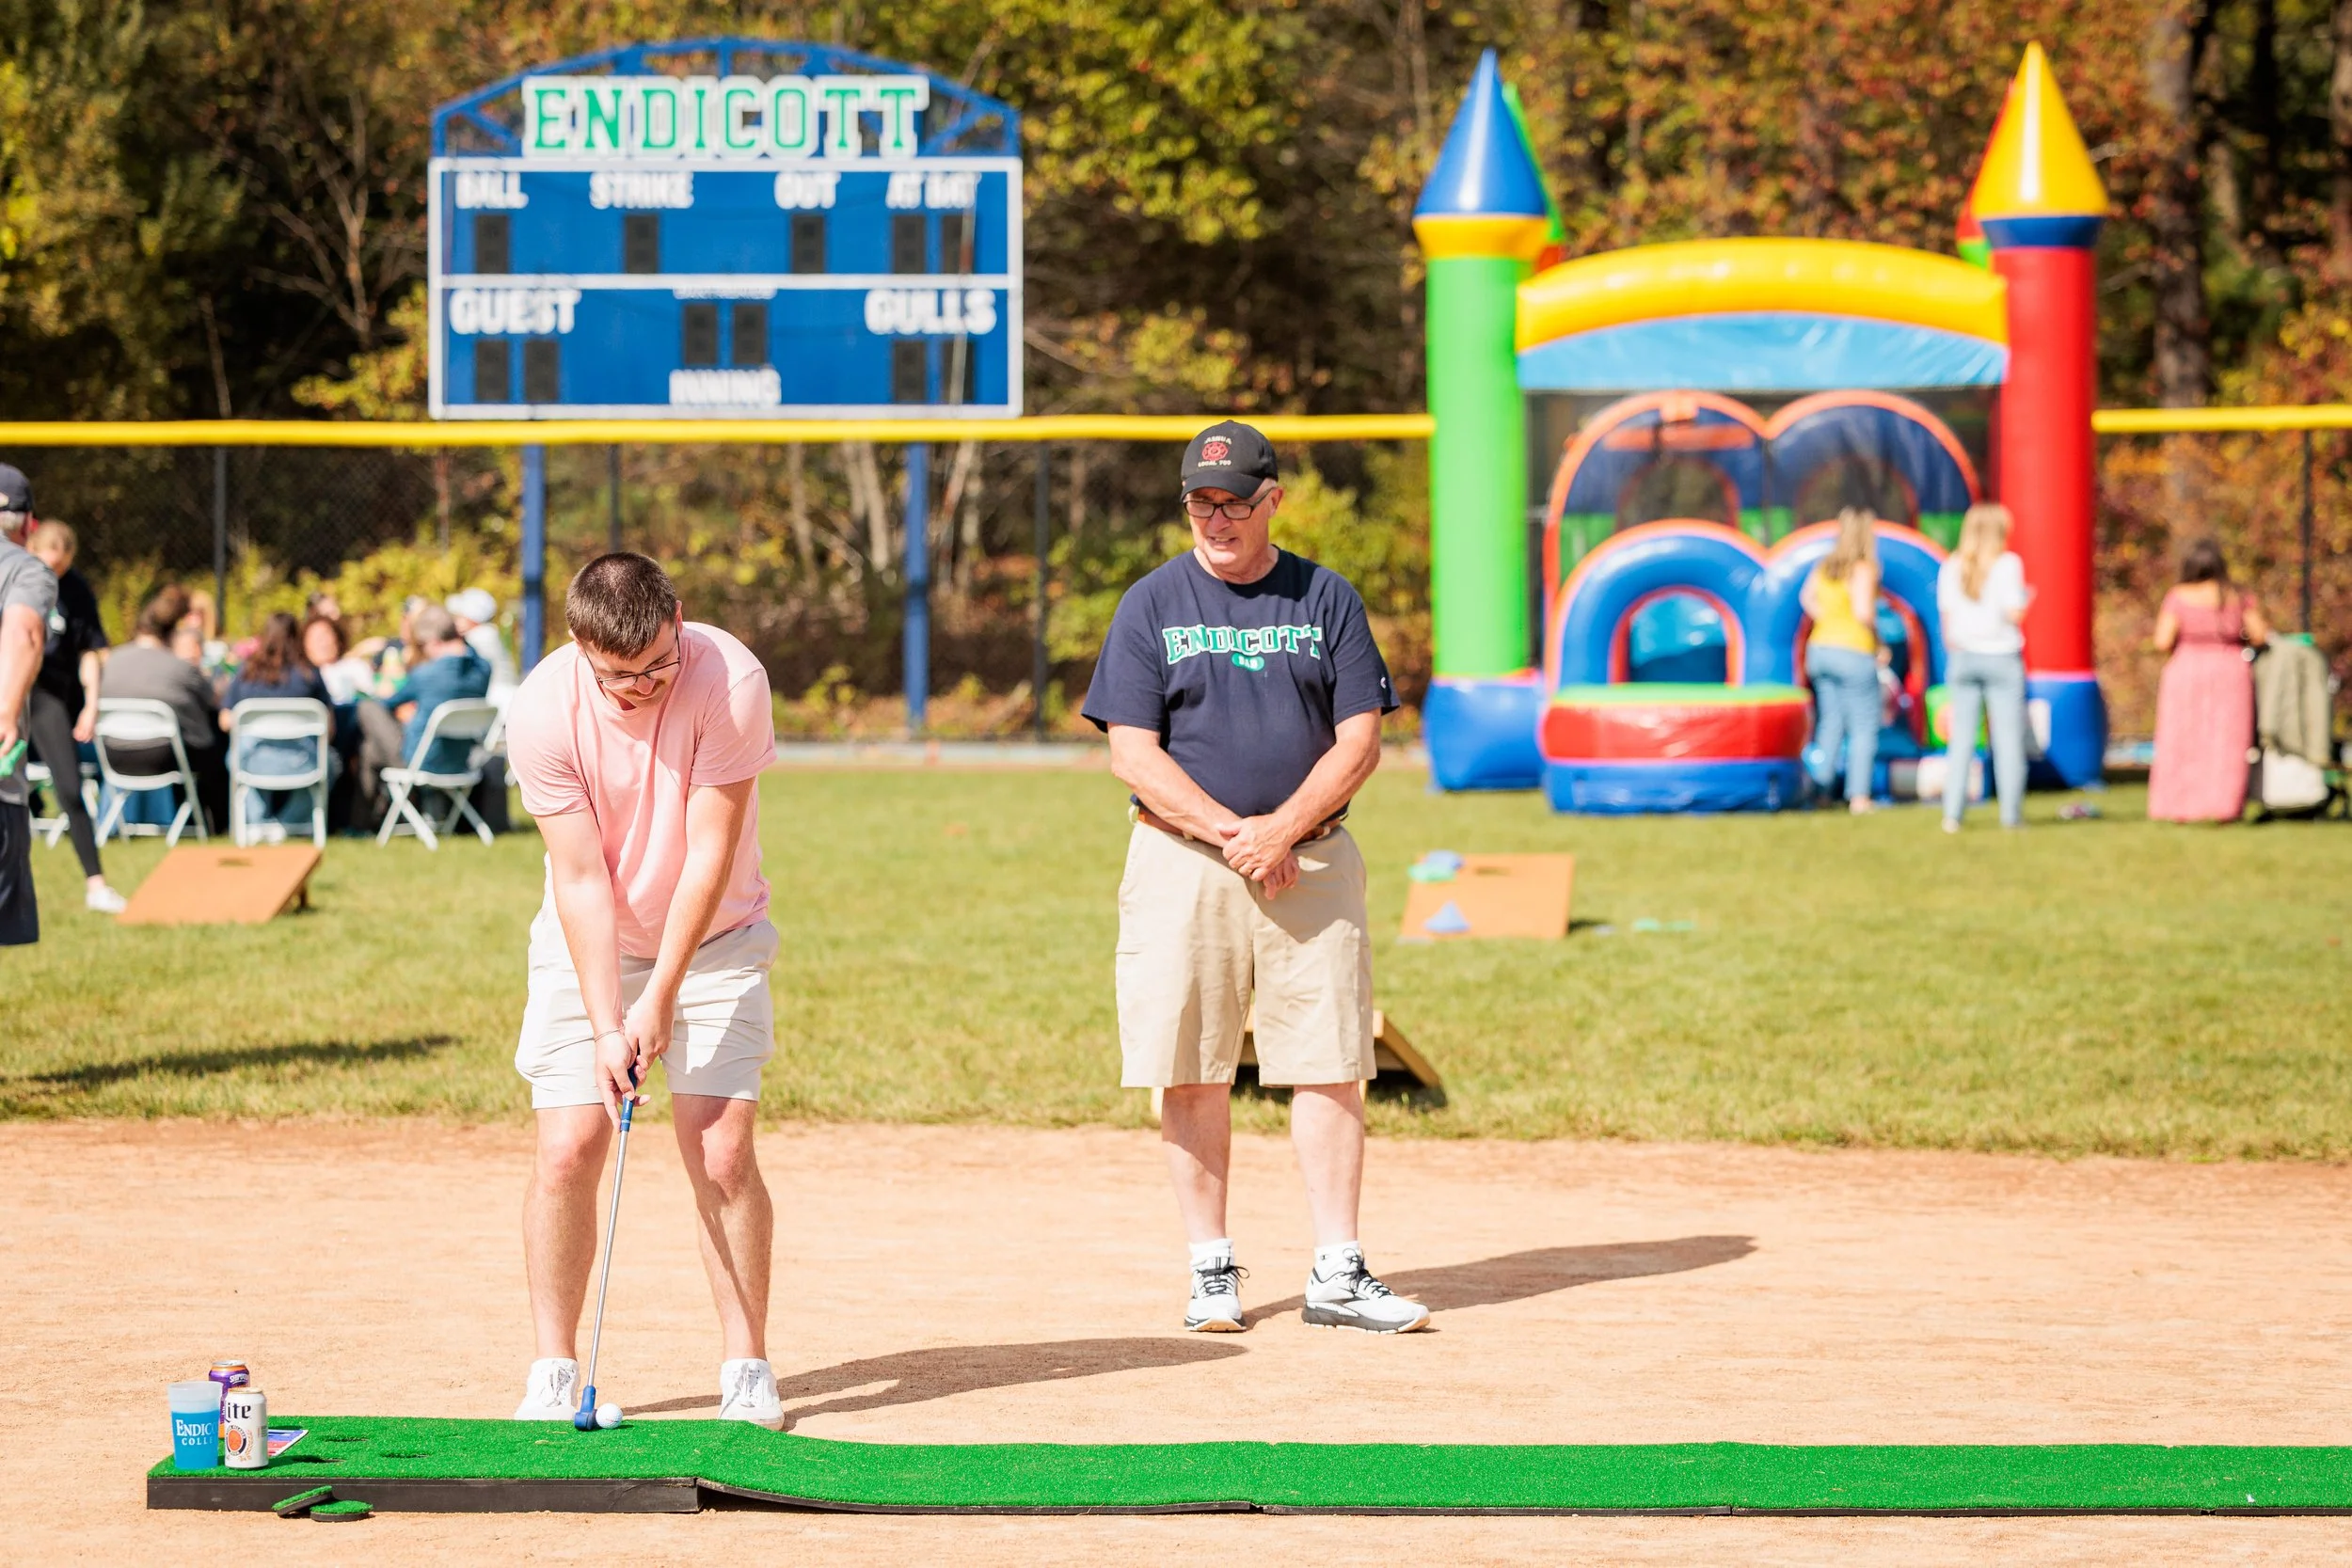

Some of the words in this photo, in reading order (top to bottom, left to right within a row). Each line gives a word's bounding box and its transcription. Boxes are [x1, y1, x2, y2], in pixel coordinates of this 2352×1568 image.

[522, 76, 929, 157] ENDICOTT
[590, 171, 694, 209] STRIKE
[774, 171, 841, 209] OUT
[449, 289, 581, 334] GUEST
[865, 289, 996, 335] GULLS
[1162, 624, 1322, 665] ENDICOTT
[225, 1402, 252, 1422] ite
